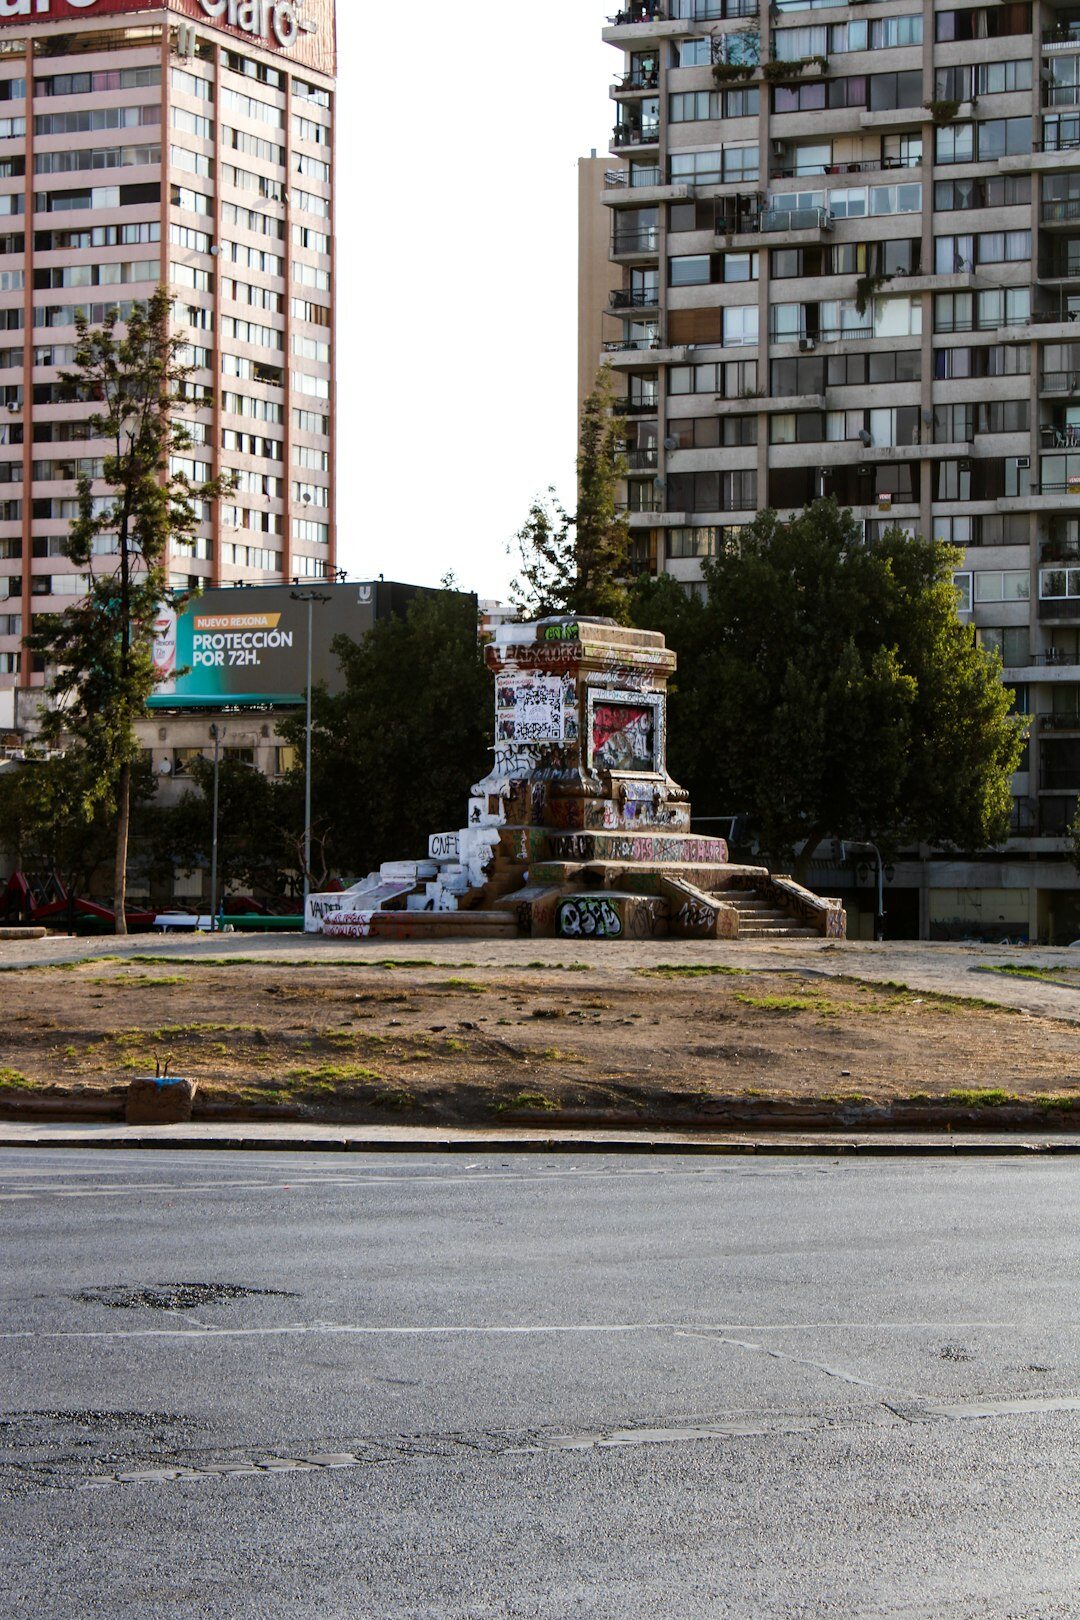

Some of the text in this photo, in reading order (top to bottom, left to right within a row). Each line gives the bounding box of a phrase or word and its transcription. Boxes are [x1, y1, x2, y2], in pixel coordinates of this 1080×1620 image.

[199, 0, 298, 48] aro
[197, 616, 268, 628] NUEVO REXONA
[193, 628, 293, 650] PROTECCIÓN
[193, 649, 261, 667] POR 72H.
